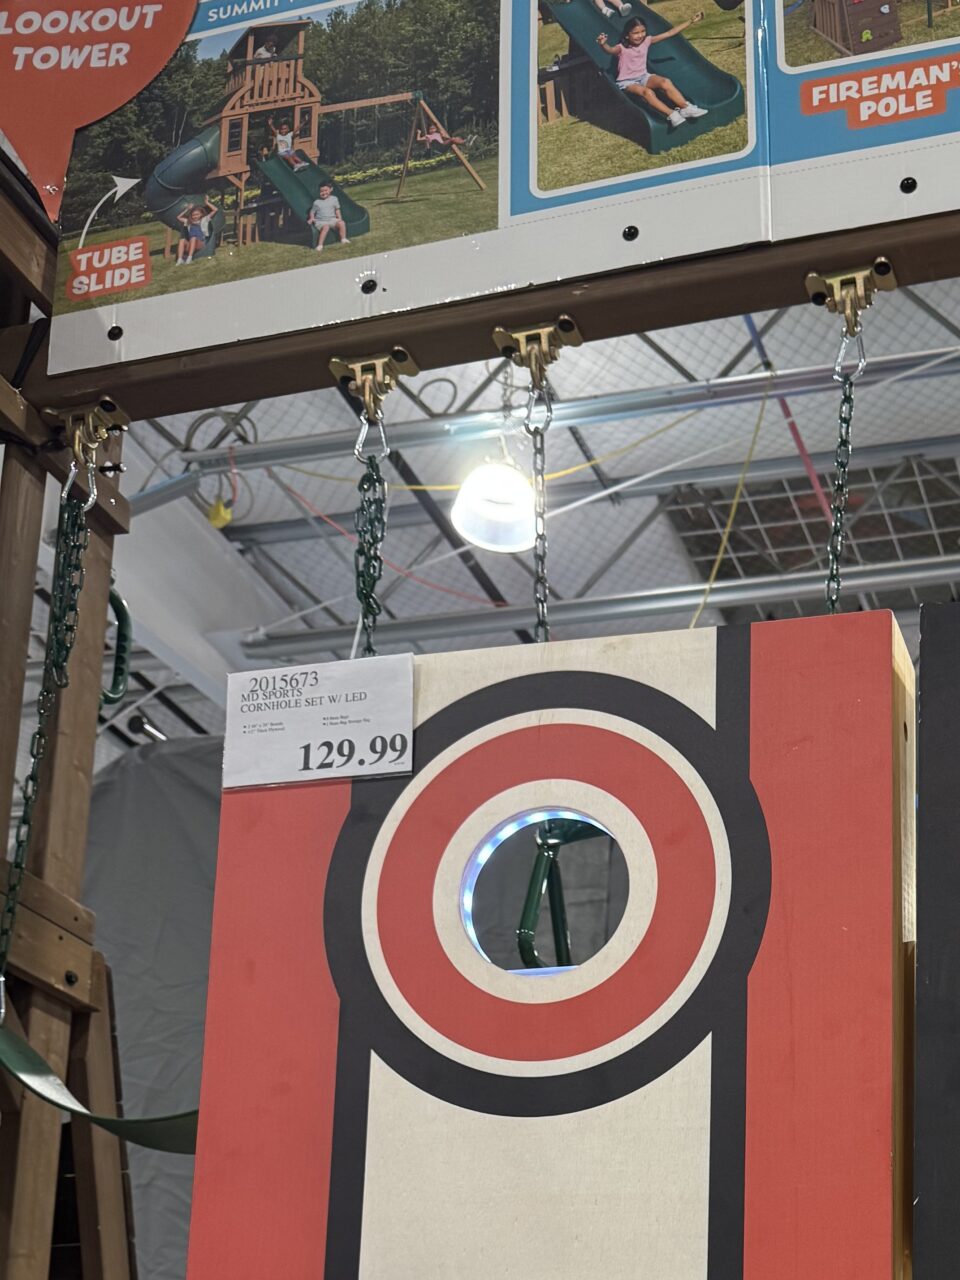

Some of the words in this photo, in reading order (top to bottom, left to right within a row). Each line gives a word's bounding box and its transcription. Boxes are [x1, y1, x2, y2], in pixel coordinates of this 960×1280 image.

[0, 4, 162, 34] LOOKOUT
[13, 42, 130, 70] TOWER
[859, 89, 934, 122] POLE
[76, 242, 144, 271] TUBE
[72, 264, 146, 295] SLIDE
[241, 692, 259, 703] MD
[262, 688, 303, 700] SPORTS
[249, 671, 319, 693] 2015673
[240, 699, 302, 713] CORNHOLE
[304, 696, 325, 707] SET
[328, 694, 342, 704] W/
[345, 691, 368, 703] LED
[298, 733, 408, 772] 129.99
